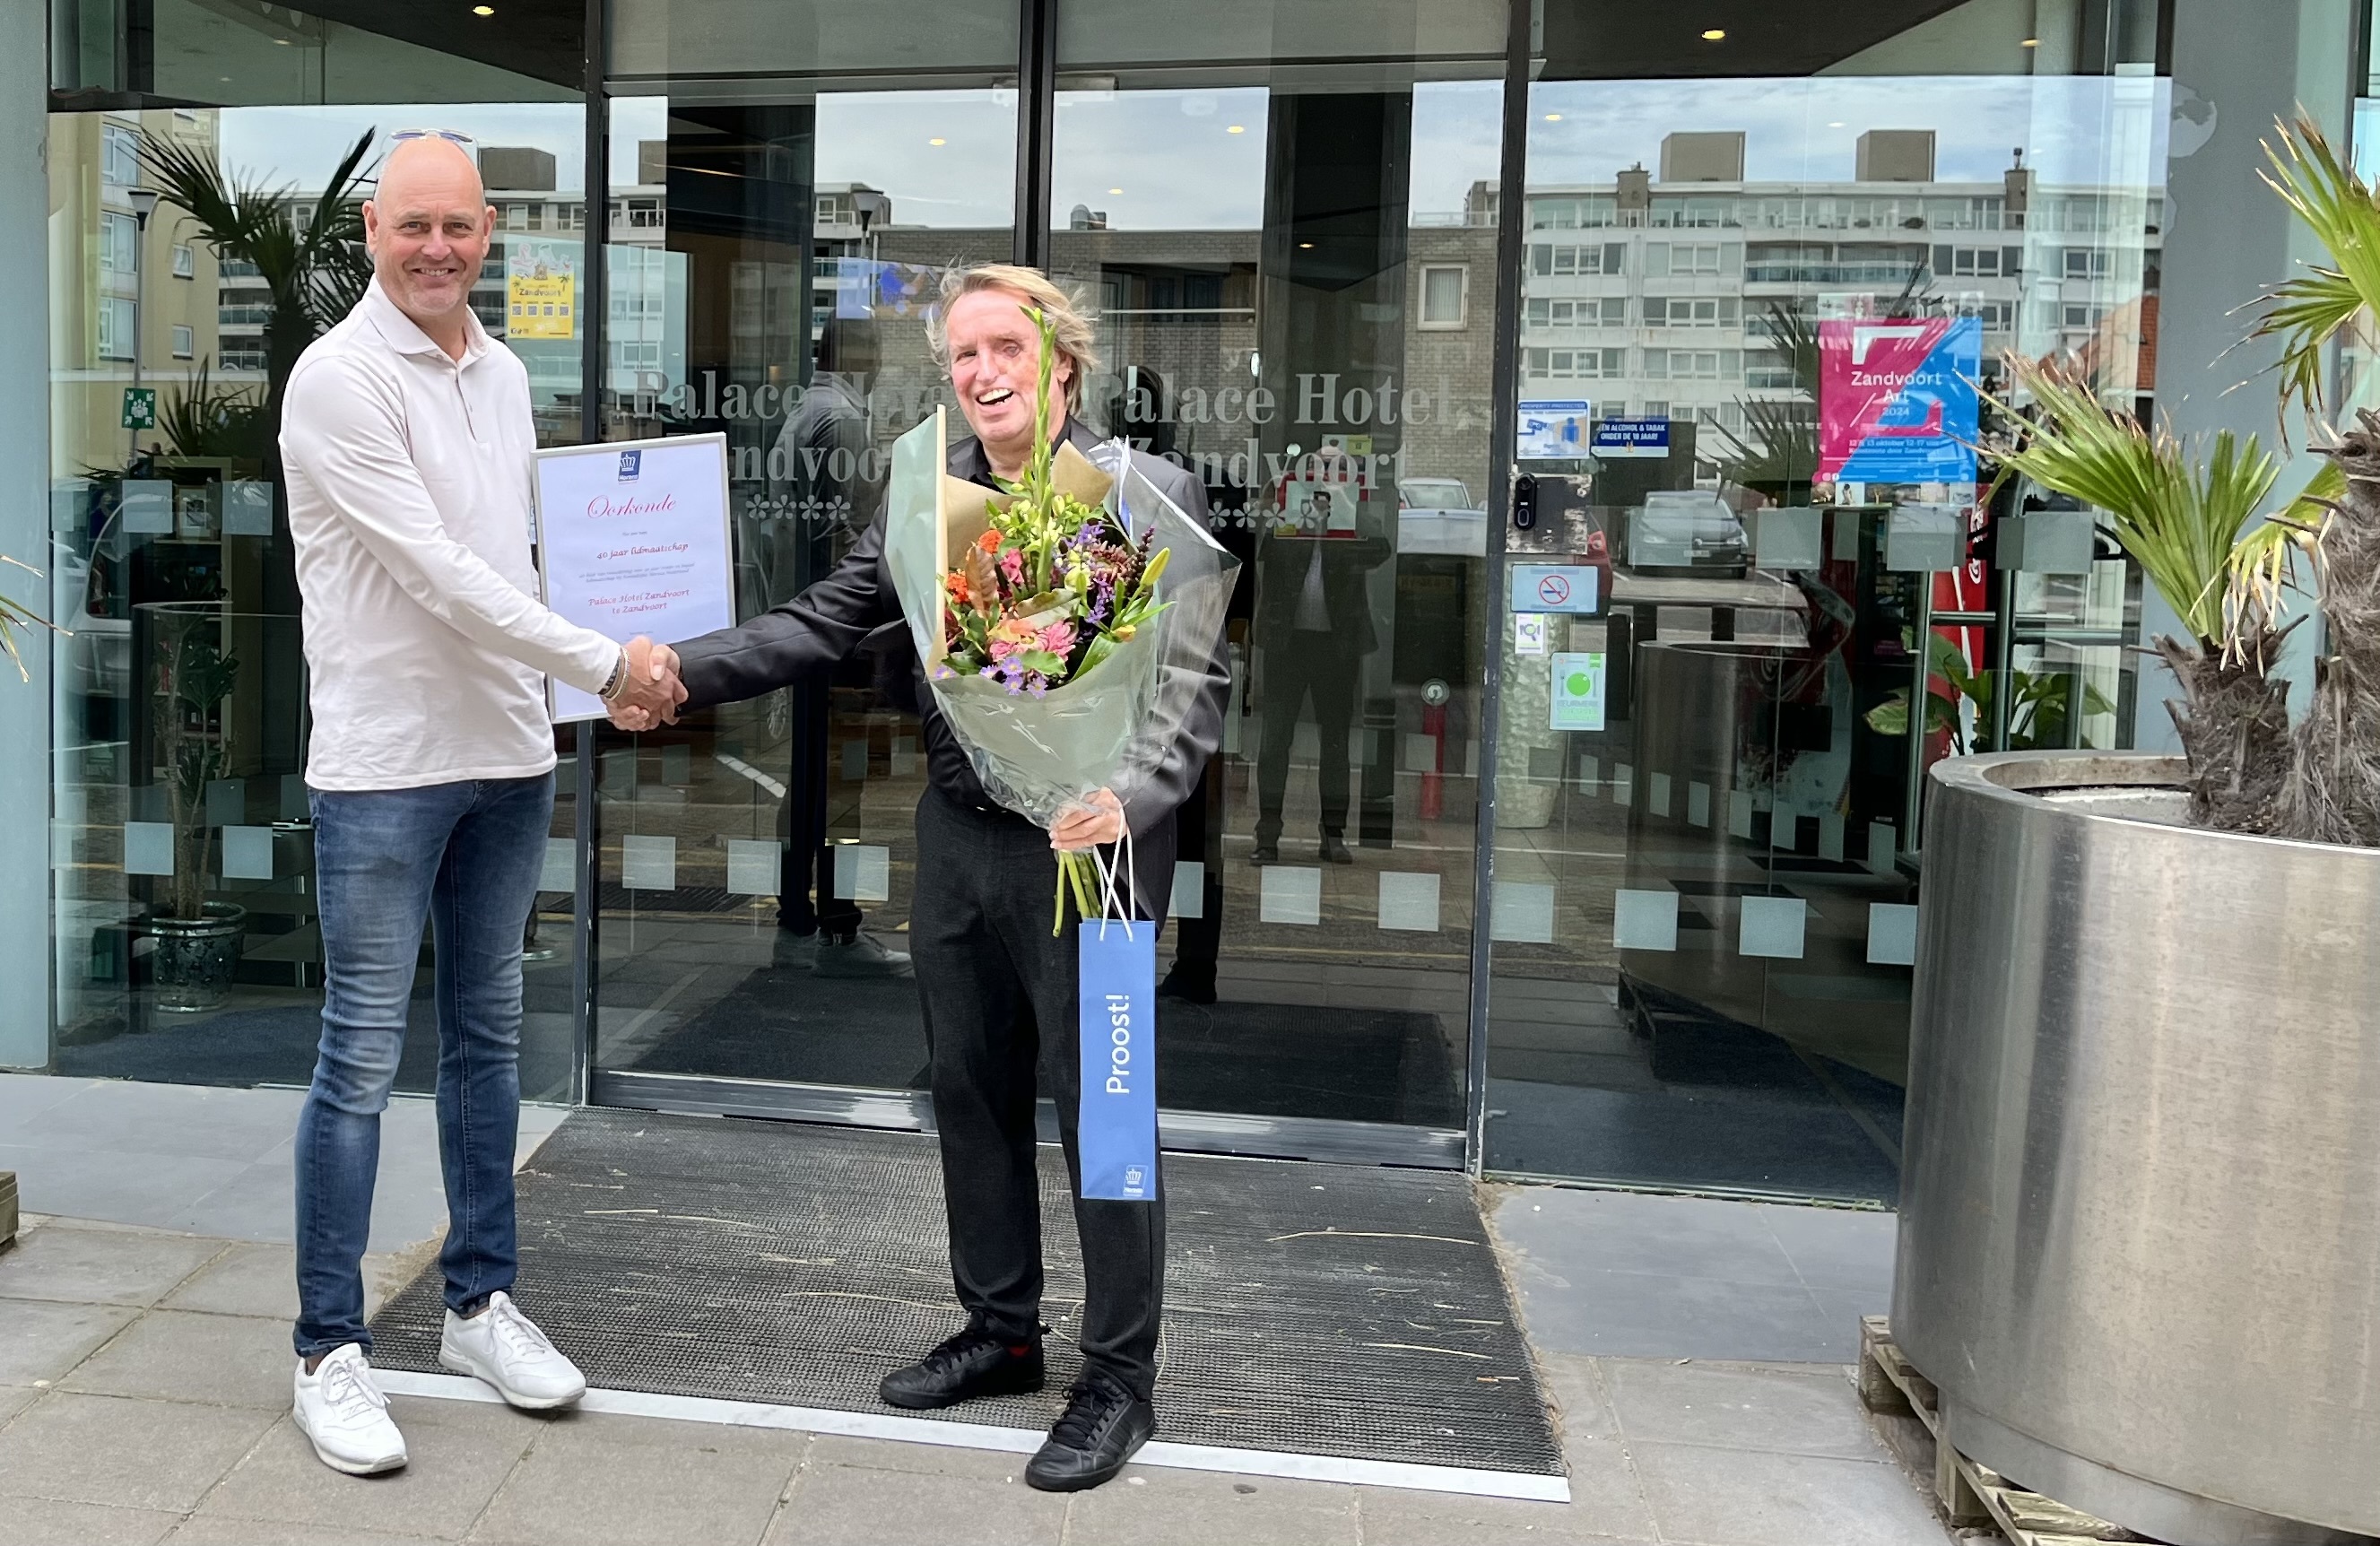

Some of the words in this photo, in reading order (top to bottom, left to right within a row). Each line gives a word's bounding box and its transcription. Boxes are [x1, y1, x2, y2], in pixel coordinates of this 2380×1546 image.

[1850, 370, 1942, 386] Zandvoort
[633, 370, 809, 420] Palace
[1086, 372, 1275, 424] Palace
[1294, 373, 1452, 425] Hotel
[1883, 388, 1909, 403] Art
[1882, 406, 1910, 417] 2024
[1611, 423, 1637, 431] ALCOHOL
[1601, 432, 1622, 440] ONDER
[1623, 432, 1631, 440] DE
[587, 493, 677, 519] Oorkonde
[609, 549, 630, 560] jaar
[630, 542, 689, 555] lidmaatschap
[588, 596, 617, 606] Palace
[619, 592, 644, 603] Hotel
[645, 589, 690, 600] Zandvoort
[621, 603, 667, 613] Zandvoort
[1106, 994, 1130, 1094] Proost!
